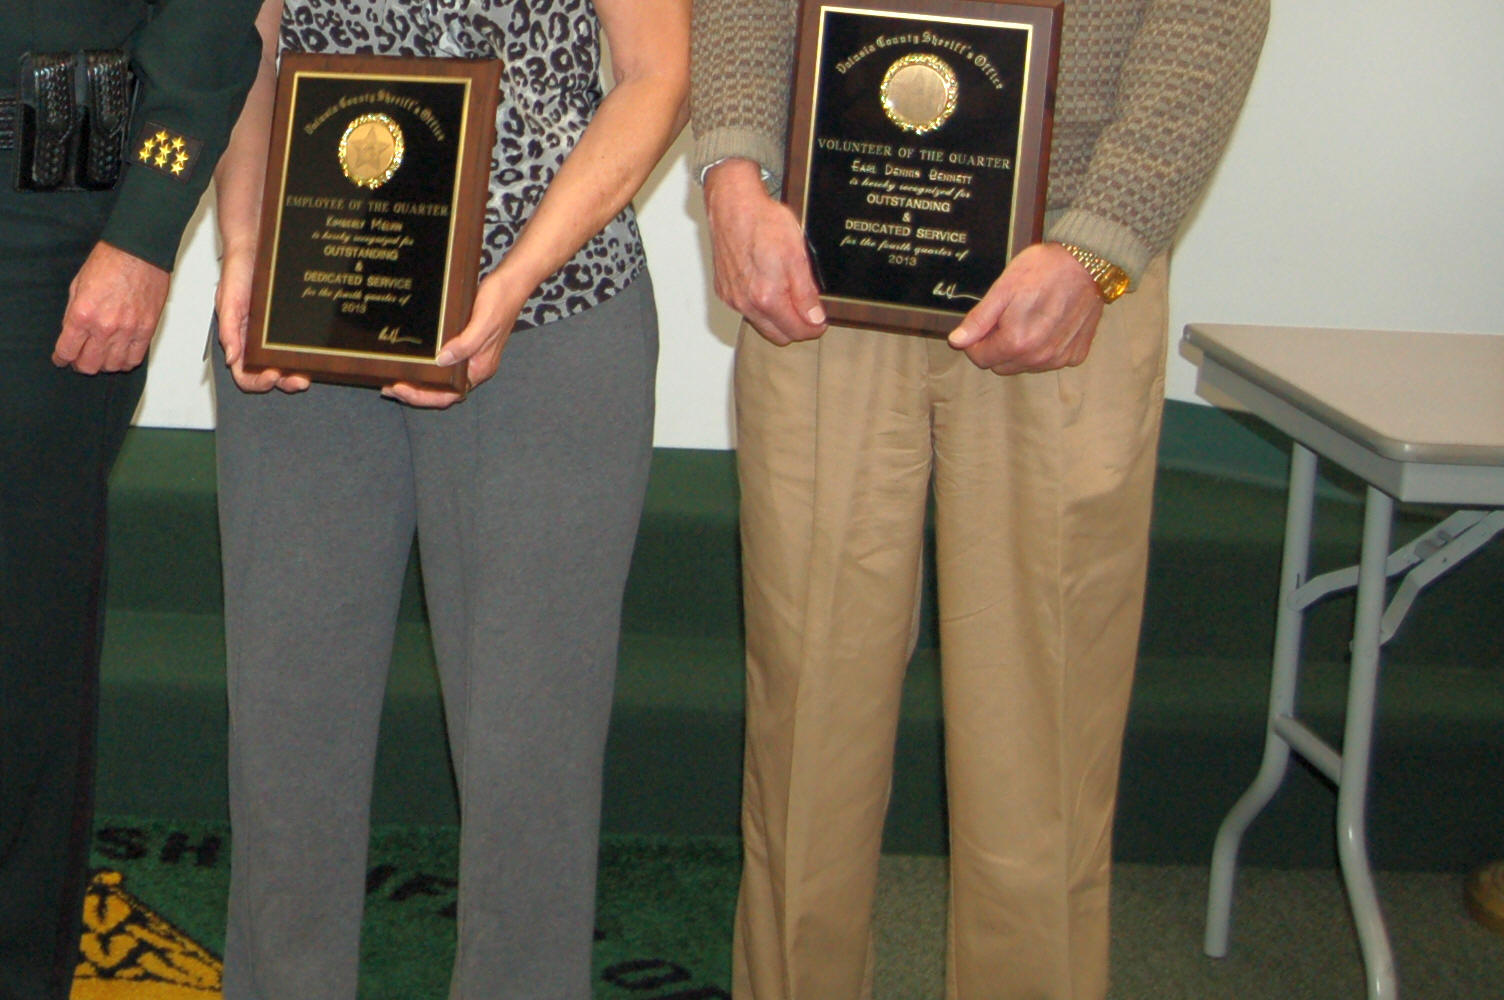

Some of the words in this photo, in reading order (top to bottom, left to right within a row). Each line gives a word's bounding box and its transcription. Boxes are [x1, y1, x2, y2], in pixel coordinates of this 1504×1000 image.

[876, 33, 919, 48] County
[922, 31, 973, 60] Sheriff's
[974, 54, 1003, 90] Office
[818, 138, 892, 156] VOLUNTEER
[898, 147, 914, 158] OF
[920, 150, 943, 162] THE
[949, 153, 1011, 170] QUARTER
[861, 177, 895, 191] hereby
[899, 183, 955, 197] recognized
[953, 187, 970, 199] for
[287, 195, 344, 210] EMPLOYEE
[348, 200, 362, 210] OF
[368, 201, 389, 213] THE
[393, 202, 449, 217] QUARTER
[866, 193, 951, 213] OUTSTANDING
[902, 212, 911, 222] &
[845, 219, 911, 237] DEDICATED
[916, 228, 967, 243] SERVICE
[323, 244, 399, 261] OUTSTANDING
[840, 236, 856, 247] for
[859, 237, 875, 247] the
[955, 249, 969, 261] of
[888, 254, 917, 266] 2013
[304, 270, 363, 286] DEDICATED
[367, 275, 412, 290] SERVICE
